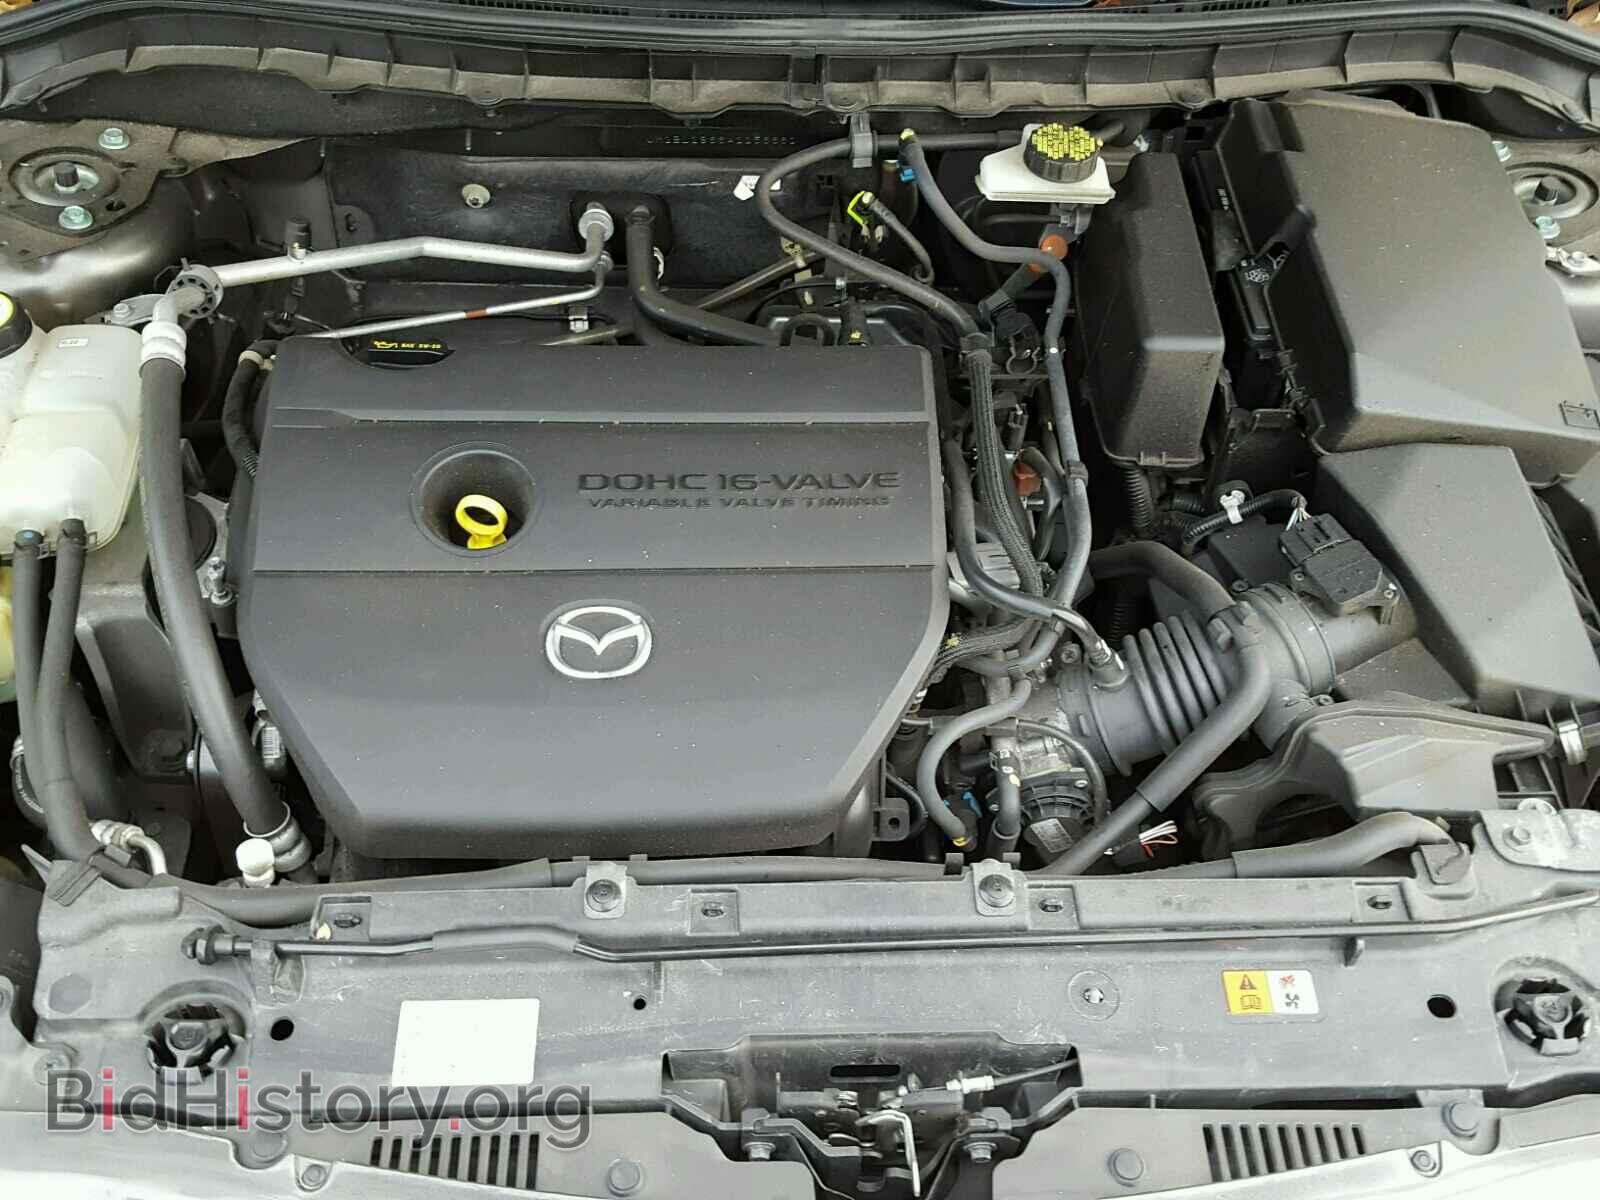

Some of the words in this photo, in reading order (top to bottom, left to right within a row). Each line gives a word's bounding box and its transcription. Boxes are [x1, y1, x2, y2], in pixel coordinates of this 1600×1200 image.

[577, 472, 709, 490] DOHC
[717, 472, 900, 490] 16-VALVE
[588, 498, 713, 509] VARIABLE
[719, 498, 796, 508] VALVE
[800, 497, 891, 508] TIMING
